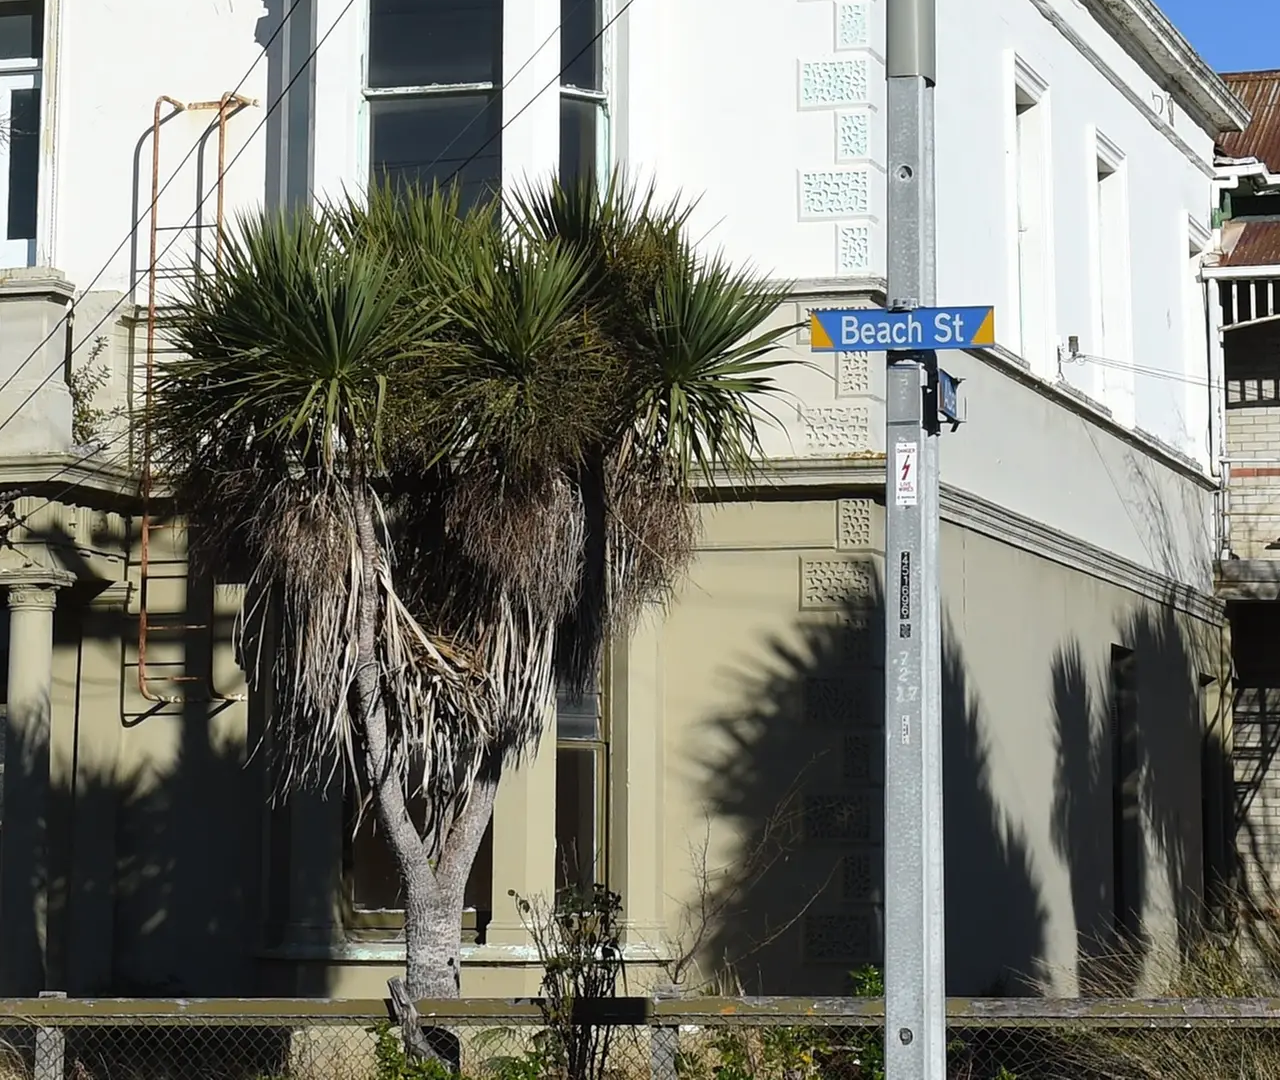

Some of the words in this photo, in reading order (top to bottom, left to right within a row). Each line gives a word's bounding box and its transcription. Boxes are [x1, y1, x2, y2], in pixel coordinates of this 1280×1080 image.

[841, 314, 922, 345] Beach
[934, 312, 964, 343] St
[901, 555, 910, 616] 451696
